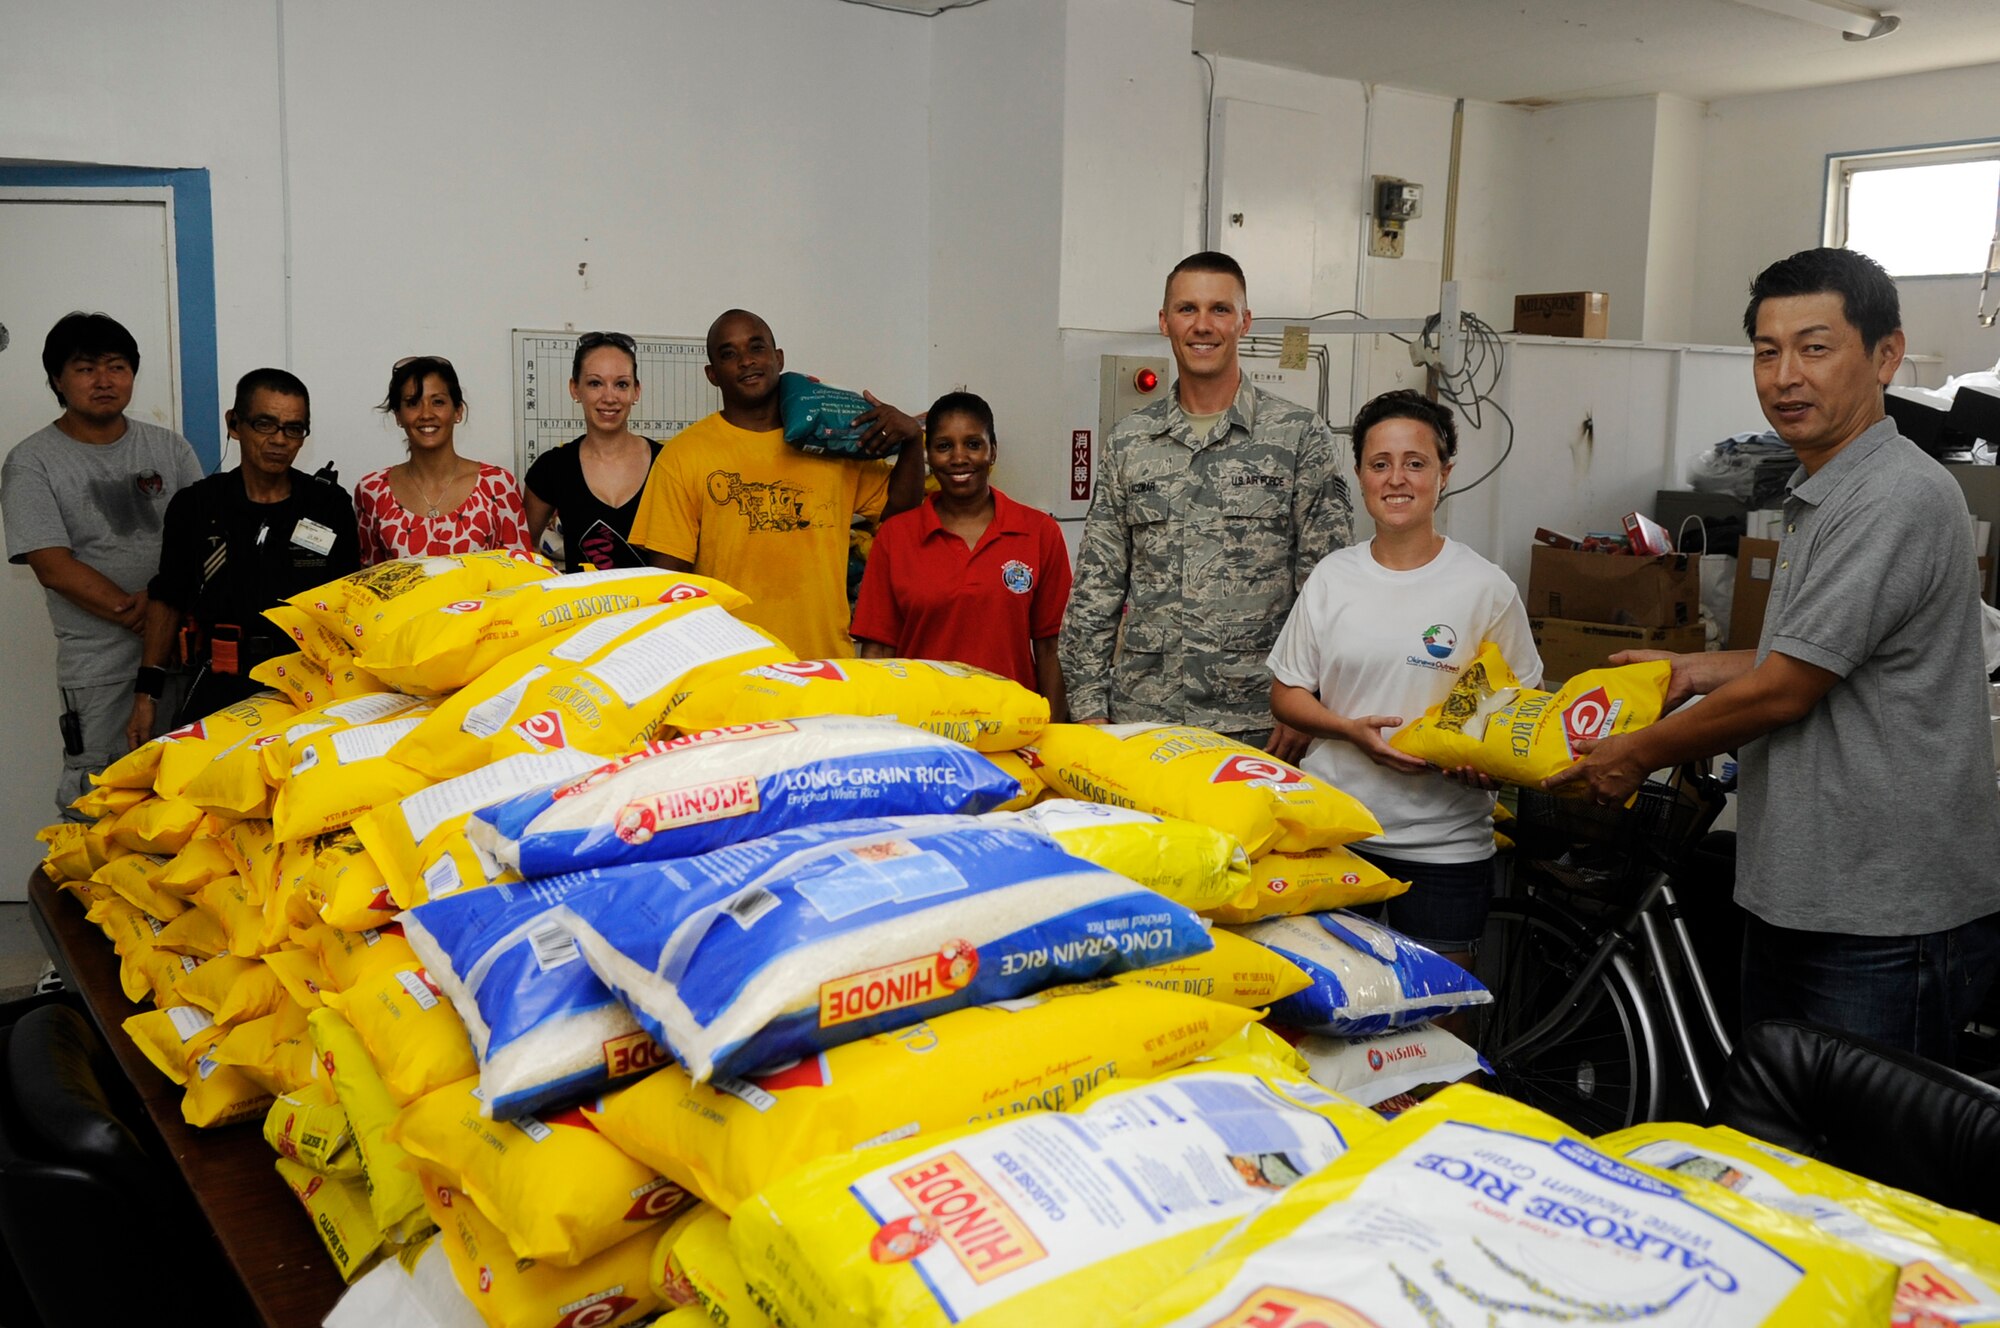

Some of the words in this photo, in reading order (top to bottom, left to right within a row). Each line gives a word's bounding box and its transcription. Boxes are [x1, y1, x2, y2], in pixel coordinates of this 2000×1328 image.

[553, 341, 558, 349] 2
[564, 341, 569, 349] 3
[665, 345, 673, 353] 12
[666, 422, 673, 430] 27
[677, 422, 684, 430] 28
[1074, 432, 1088, 483] 消火器
[1231, 476, 1245, 486] U.S.
[1246, 476, 1259, 486] AIR
[1260, 476, 1284, 487] FORCE
[538, 607, 572, 628] RICE
[577, 594, 641, 619] CALROSE
[1599, 701, 1620, 738] DIAMON
[1149, 738, 1186, 765] RICE
[1511, 721, 1537, 757] RICE
[785, 769, 842, 791] LONG
[846, 766, 911, 786] GRAIN
[915, 766, 957, 785] RICE
[1058, 767, 1108, 804] CALROSE
[656, 780, 754, 822] HINODE
[787, 790, 828, 805] Enriched
[831, 788, 858, 800] White
[860, 787, 881, 798] Rice
[1085, 920, 1105, 935] Rice
[1106, 916, 1129, 932] White
[1131, 912, 1172, 928] Enriched
[1054, 934, 1118, 966] GRAIN
[1120, 928, 1173, 955] LONG
[1000, 947, 1048, 976] RICE
[829, 967, 933, 1021] HINODE
[1413, 1152, 1522, 1206] RICE
[1472, 1148, 1536, 1183] Grain
[1016, 1171, 1068, 1225] CALROSE
[1541, 1174, 1637, 1224] Medium
[902, 1161, 1026, 1272] HINODE
[1642, 1213, 1713, 1252] White
[1525, 1195, 1740, 1295] CALROSE
